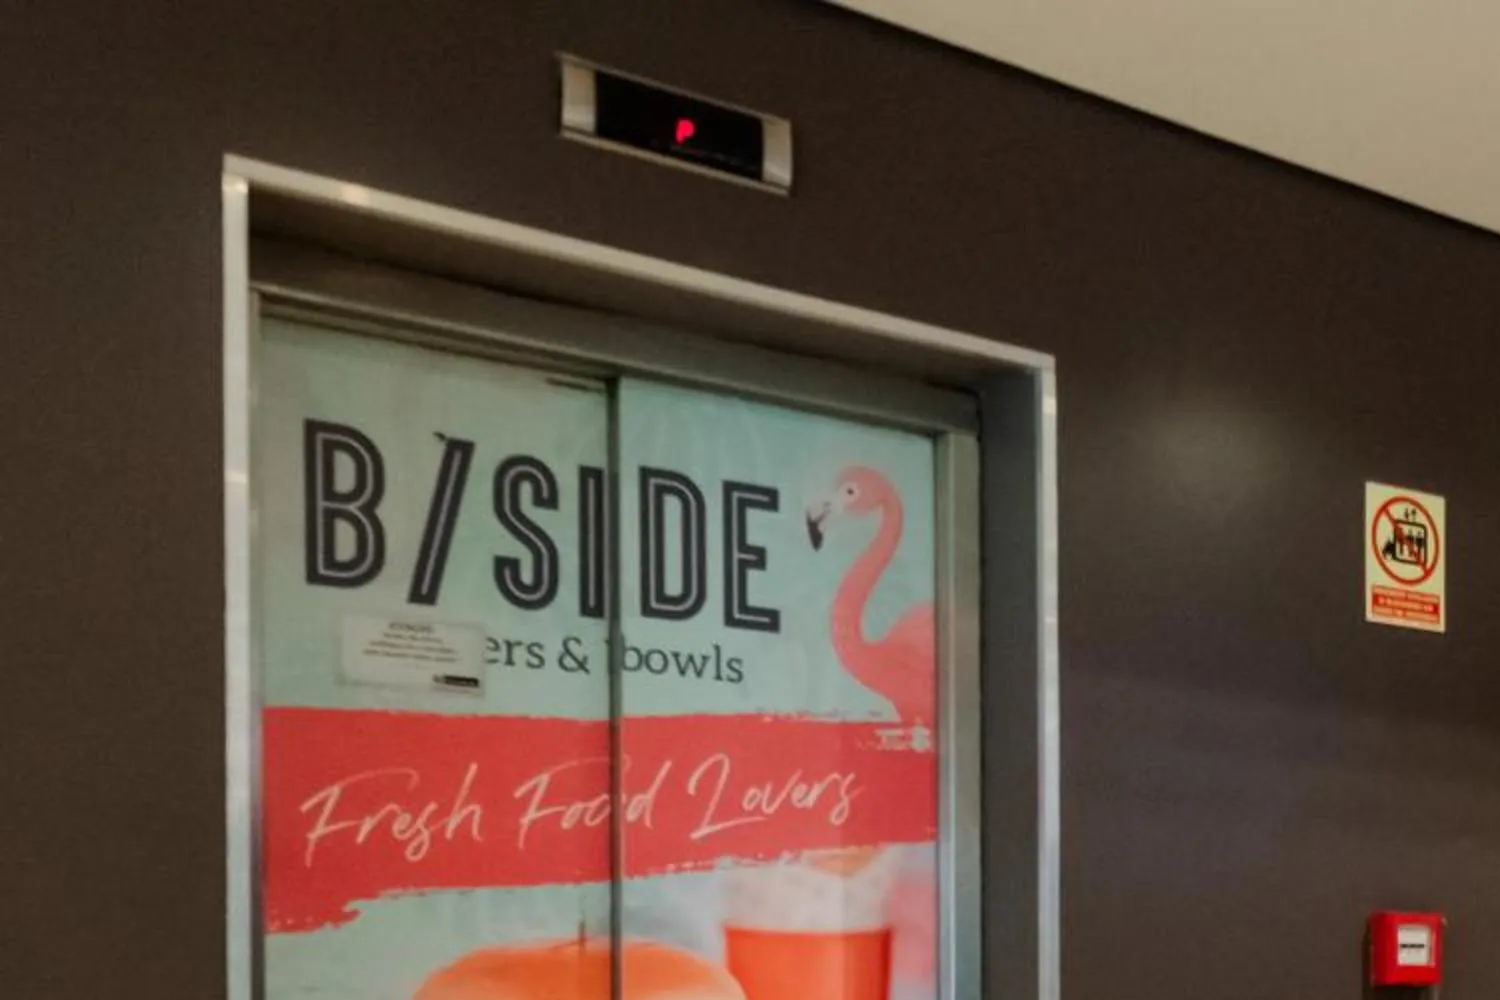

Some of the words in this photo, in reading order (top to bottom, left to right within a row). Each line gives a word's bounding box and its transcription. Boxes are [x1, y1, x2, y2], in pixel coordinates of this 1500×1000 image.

[303, 418, 781, 633] B/SIDE
[300, 762, 483, 868] Fresh
[514, 760, 673, 850] Food
[687, 753, 863, 840] Lovers
